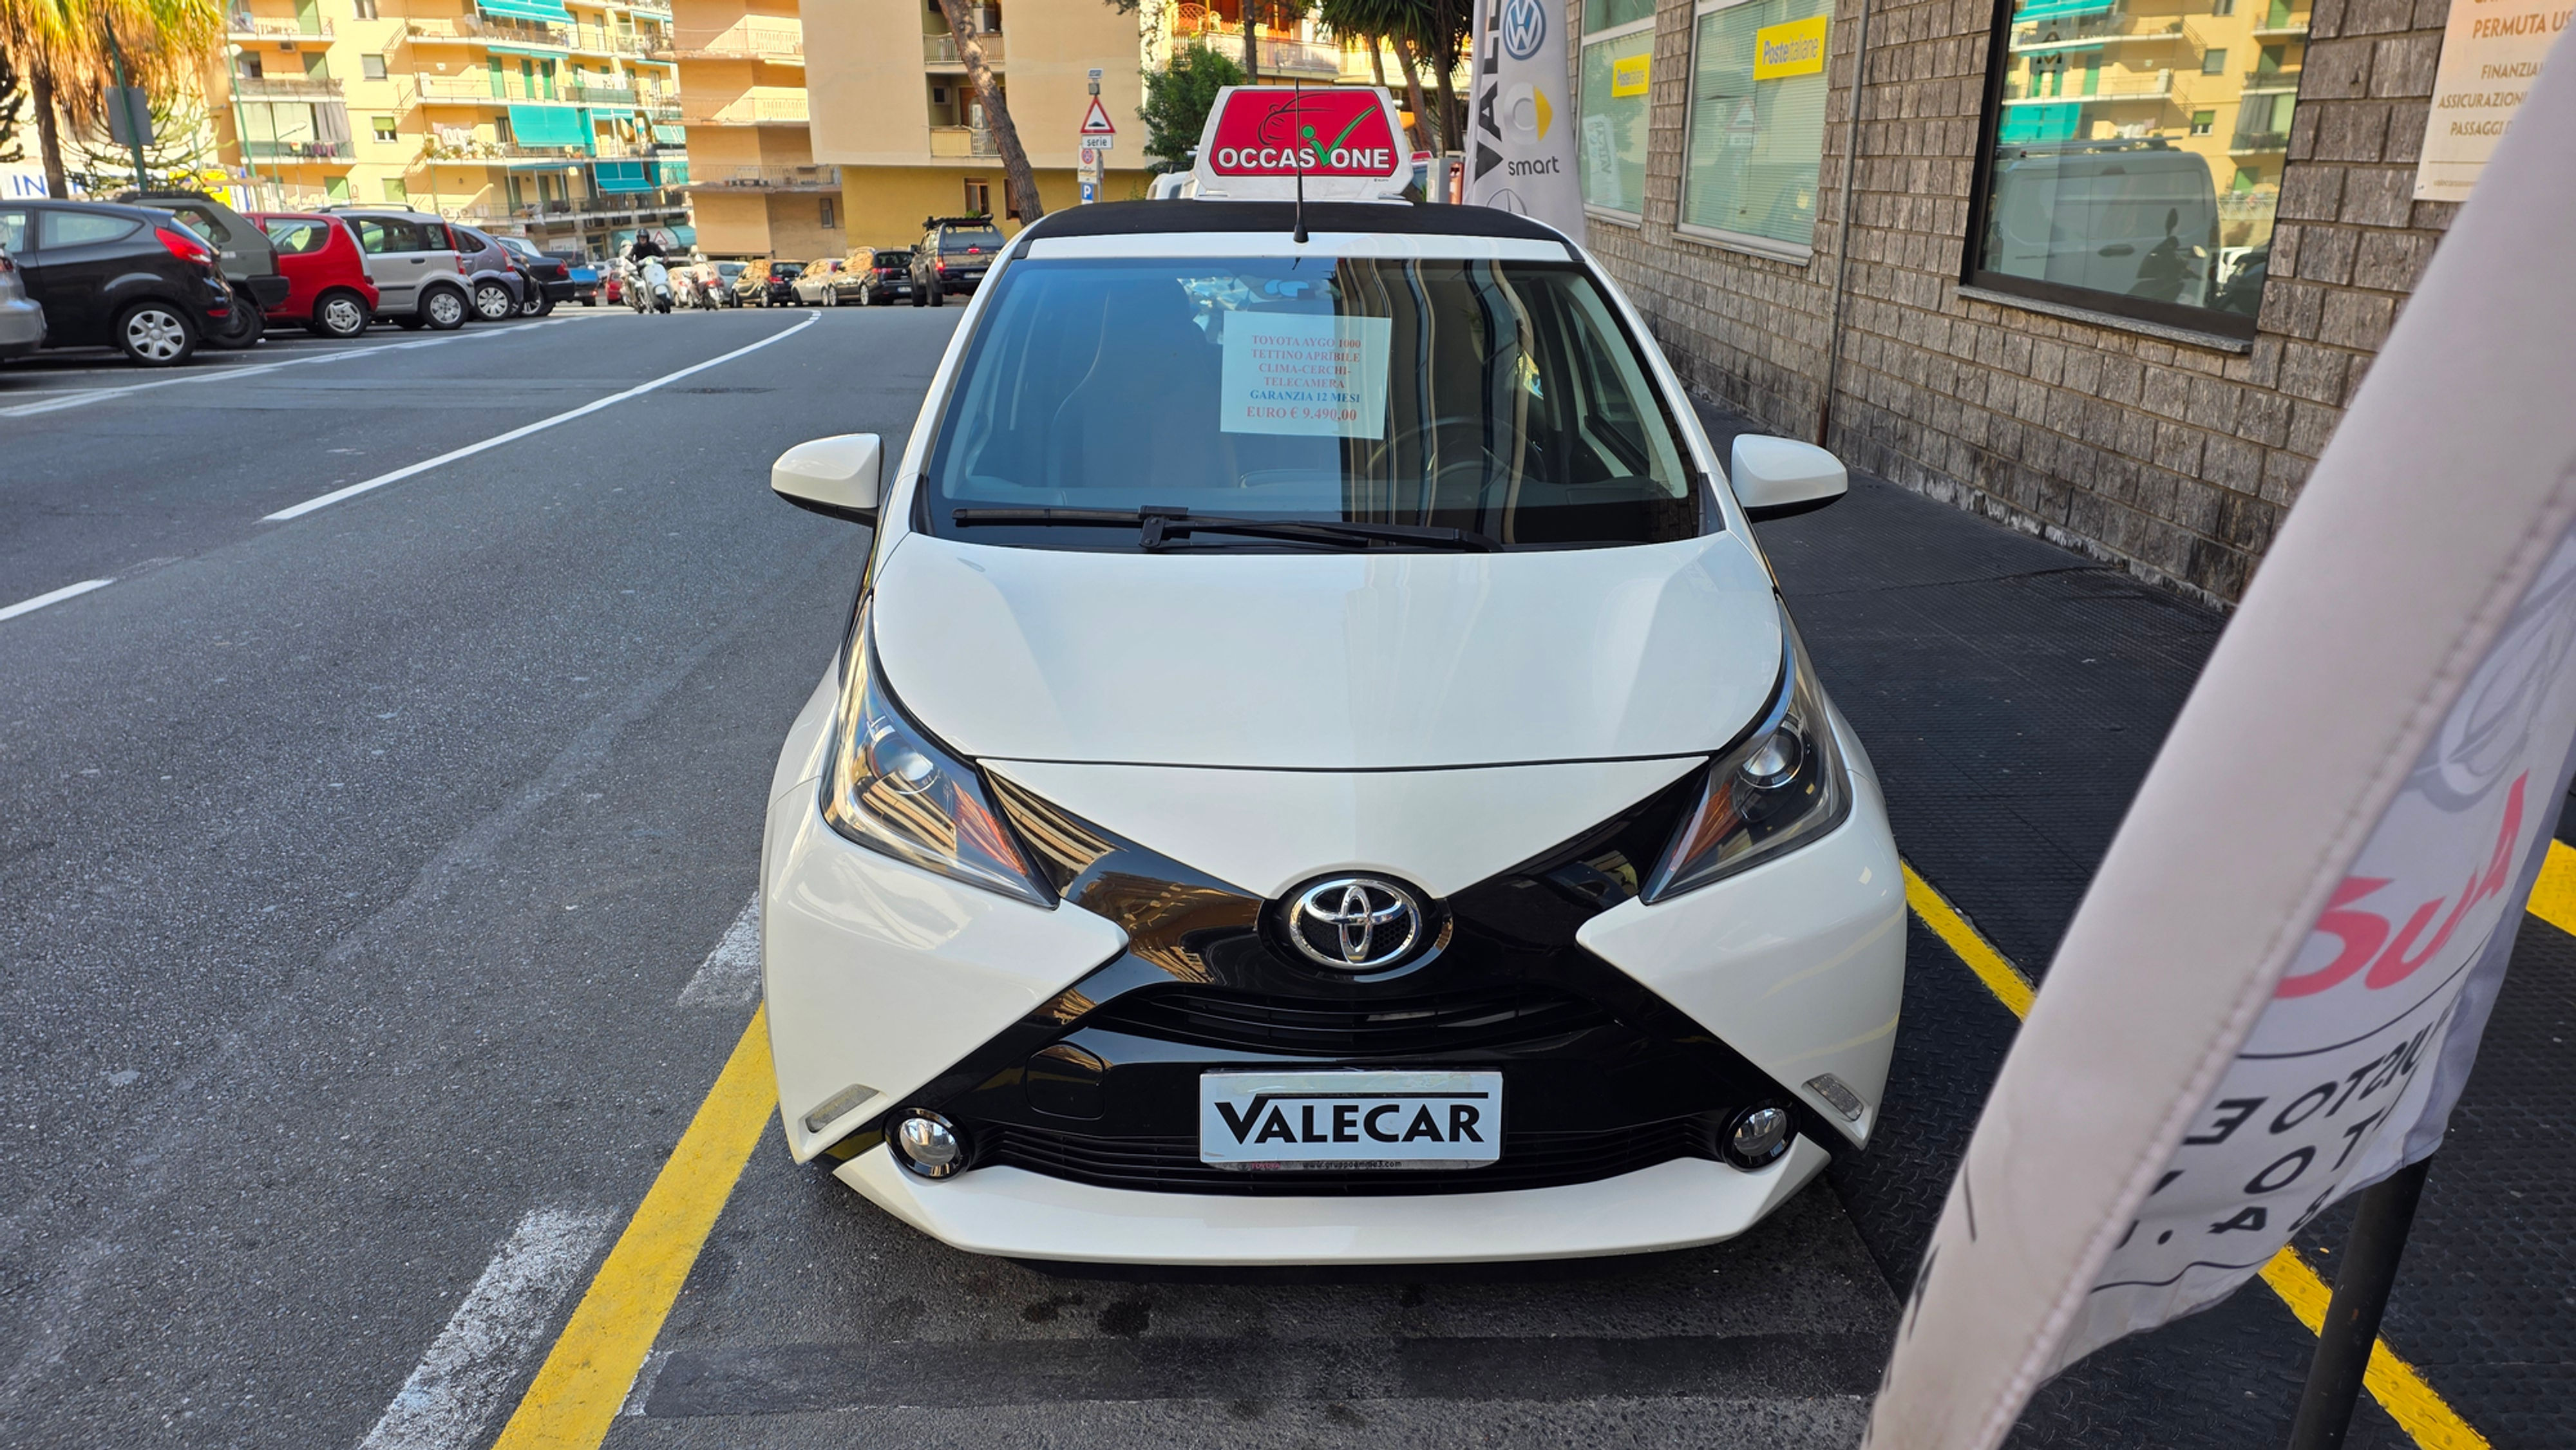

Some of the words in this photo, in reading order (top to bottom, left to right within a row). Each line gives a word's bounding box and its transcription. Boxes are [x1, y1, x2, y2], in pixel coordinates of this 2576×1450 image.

[2472, 14, 2546, 39] PERMUTA
[2481, 62, 2543, 80] FINANZIA
[1474, 0, 1504, 184] VAL
[1086, 137, 1107, 147] serie
[1508, 156, 1560, 176] smart
[1083, 185, 1092, 198] P
[1252, 334, 1300, 347] TOYOTA
[1302, 336, 1336, 348] AYGO
[1338, 339, 1361, 349] 1000
[1251, 348, 1303, 361] TETTINO
[1306, 351, 1361, 362] APRIBILE
[1264, 377, 1345, 388] TELECAMERA
[1249, 389, 1314, 402] GARANZIA
[1316, 391, 1328, 402] 12
[1330, 392, 1361, 403] MESI
[1246, 406, 1287, 419] EURO
[1290, 407, 1300, 419] €
[1302, 407, 1358, 421] 9.490,00
[1213, 1092, 1489, 1145] VALECAR
